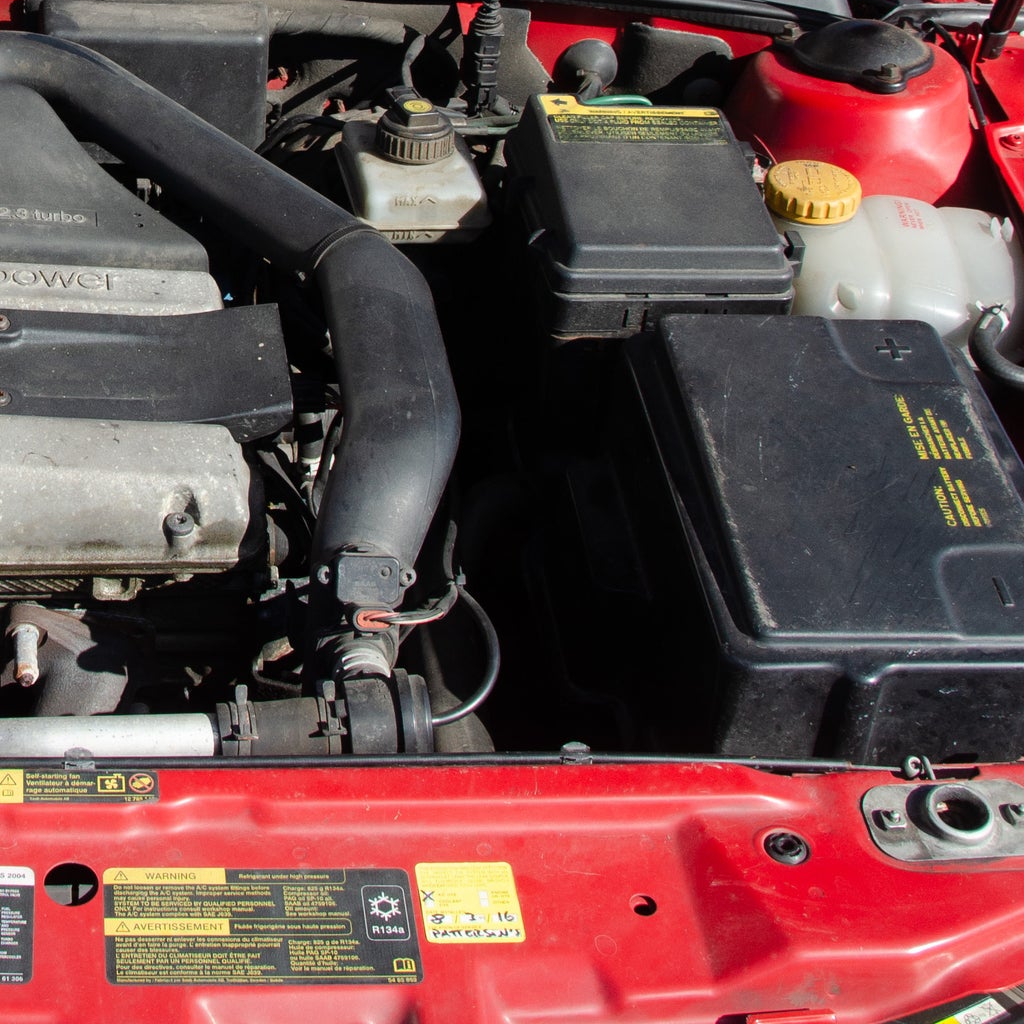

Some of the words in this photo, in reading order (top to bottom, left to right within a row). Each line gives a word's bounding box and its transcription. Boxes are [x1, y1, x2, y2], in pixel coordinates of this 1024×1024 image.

[33, 208, 86, 224] turbo
[906, 425, 920, 438] EN
[912, 439, 929, 460] MISE
[933, 485, 957, 527] CAUTION:
[26, 773, 68, 781] Self-starting
[69, 773, 81, 781] fan
[145, 872, 197, 881] WARNING
[133, 922, 224, 931] AVERTISSEMENT
[371, 925, 406, 934] R134a
